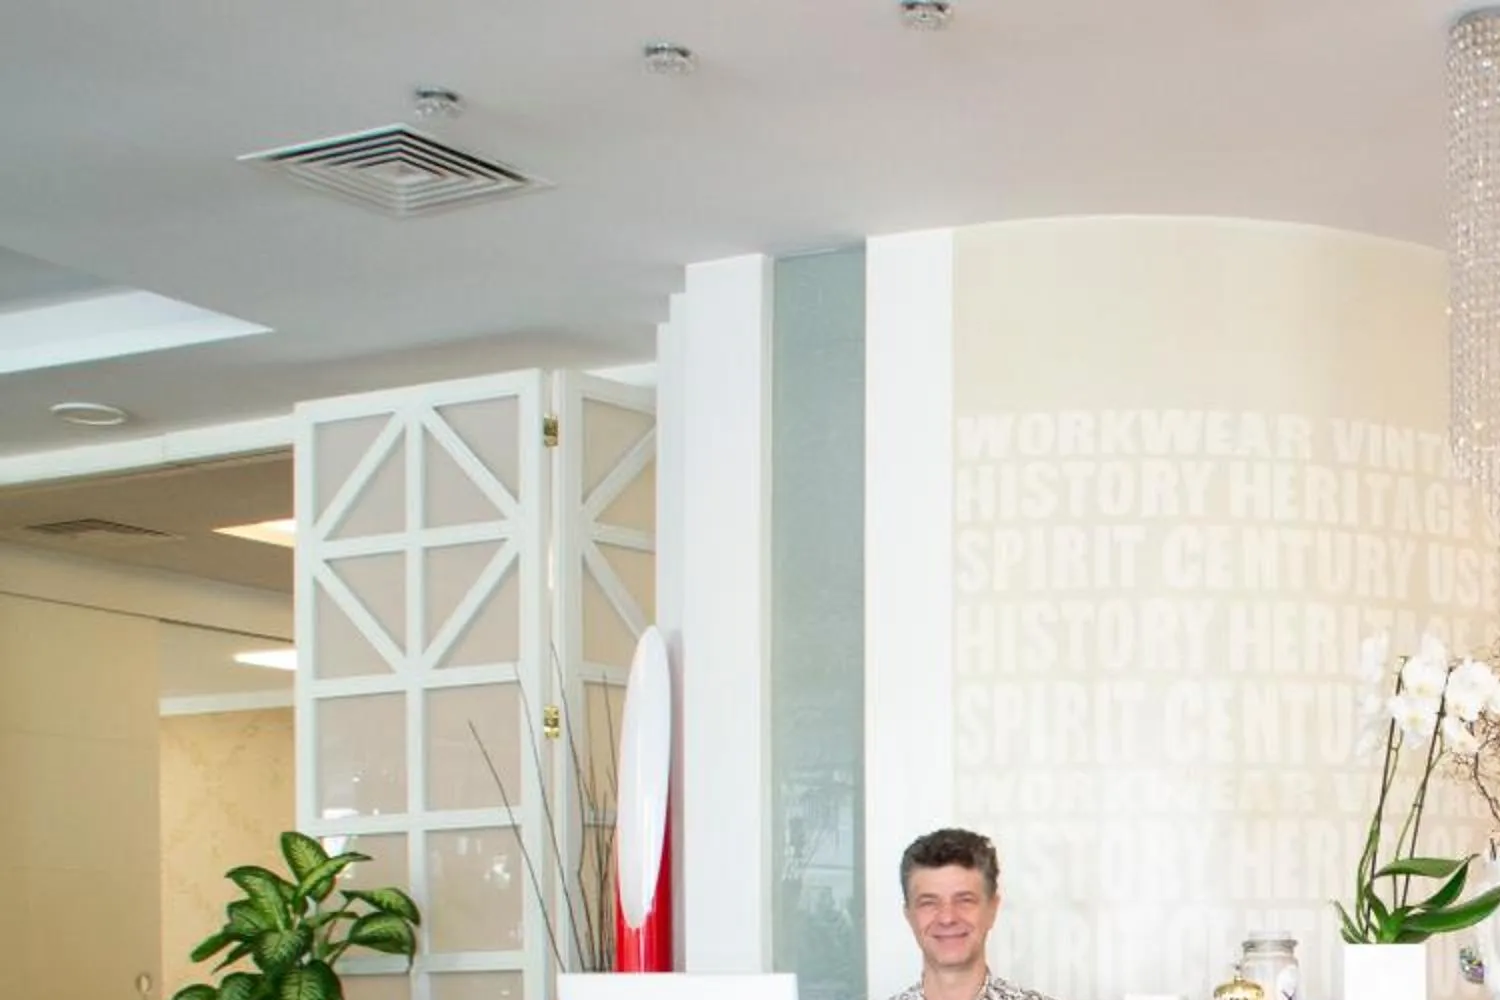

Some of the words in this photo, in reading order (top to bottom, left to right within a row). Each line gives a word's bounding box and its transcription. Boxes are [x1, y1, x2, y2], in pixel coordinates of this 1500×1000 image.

[956, 409, 1313, 460] WORKWEAR
[956, 460, 1215, 522] HISTORY
[1229, 460, 1472, 538] HERITAGE
[958, 525, 1145, 593] SPIRIT
[1162, 524, 1416, 600] CENTURY
[956, 599, 1215, 676] HISTORY
[958, 682, 1146, 768] SPIRIT
[1162, 681, 1388, 770] CENTU
